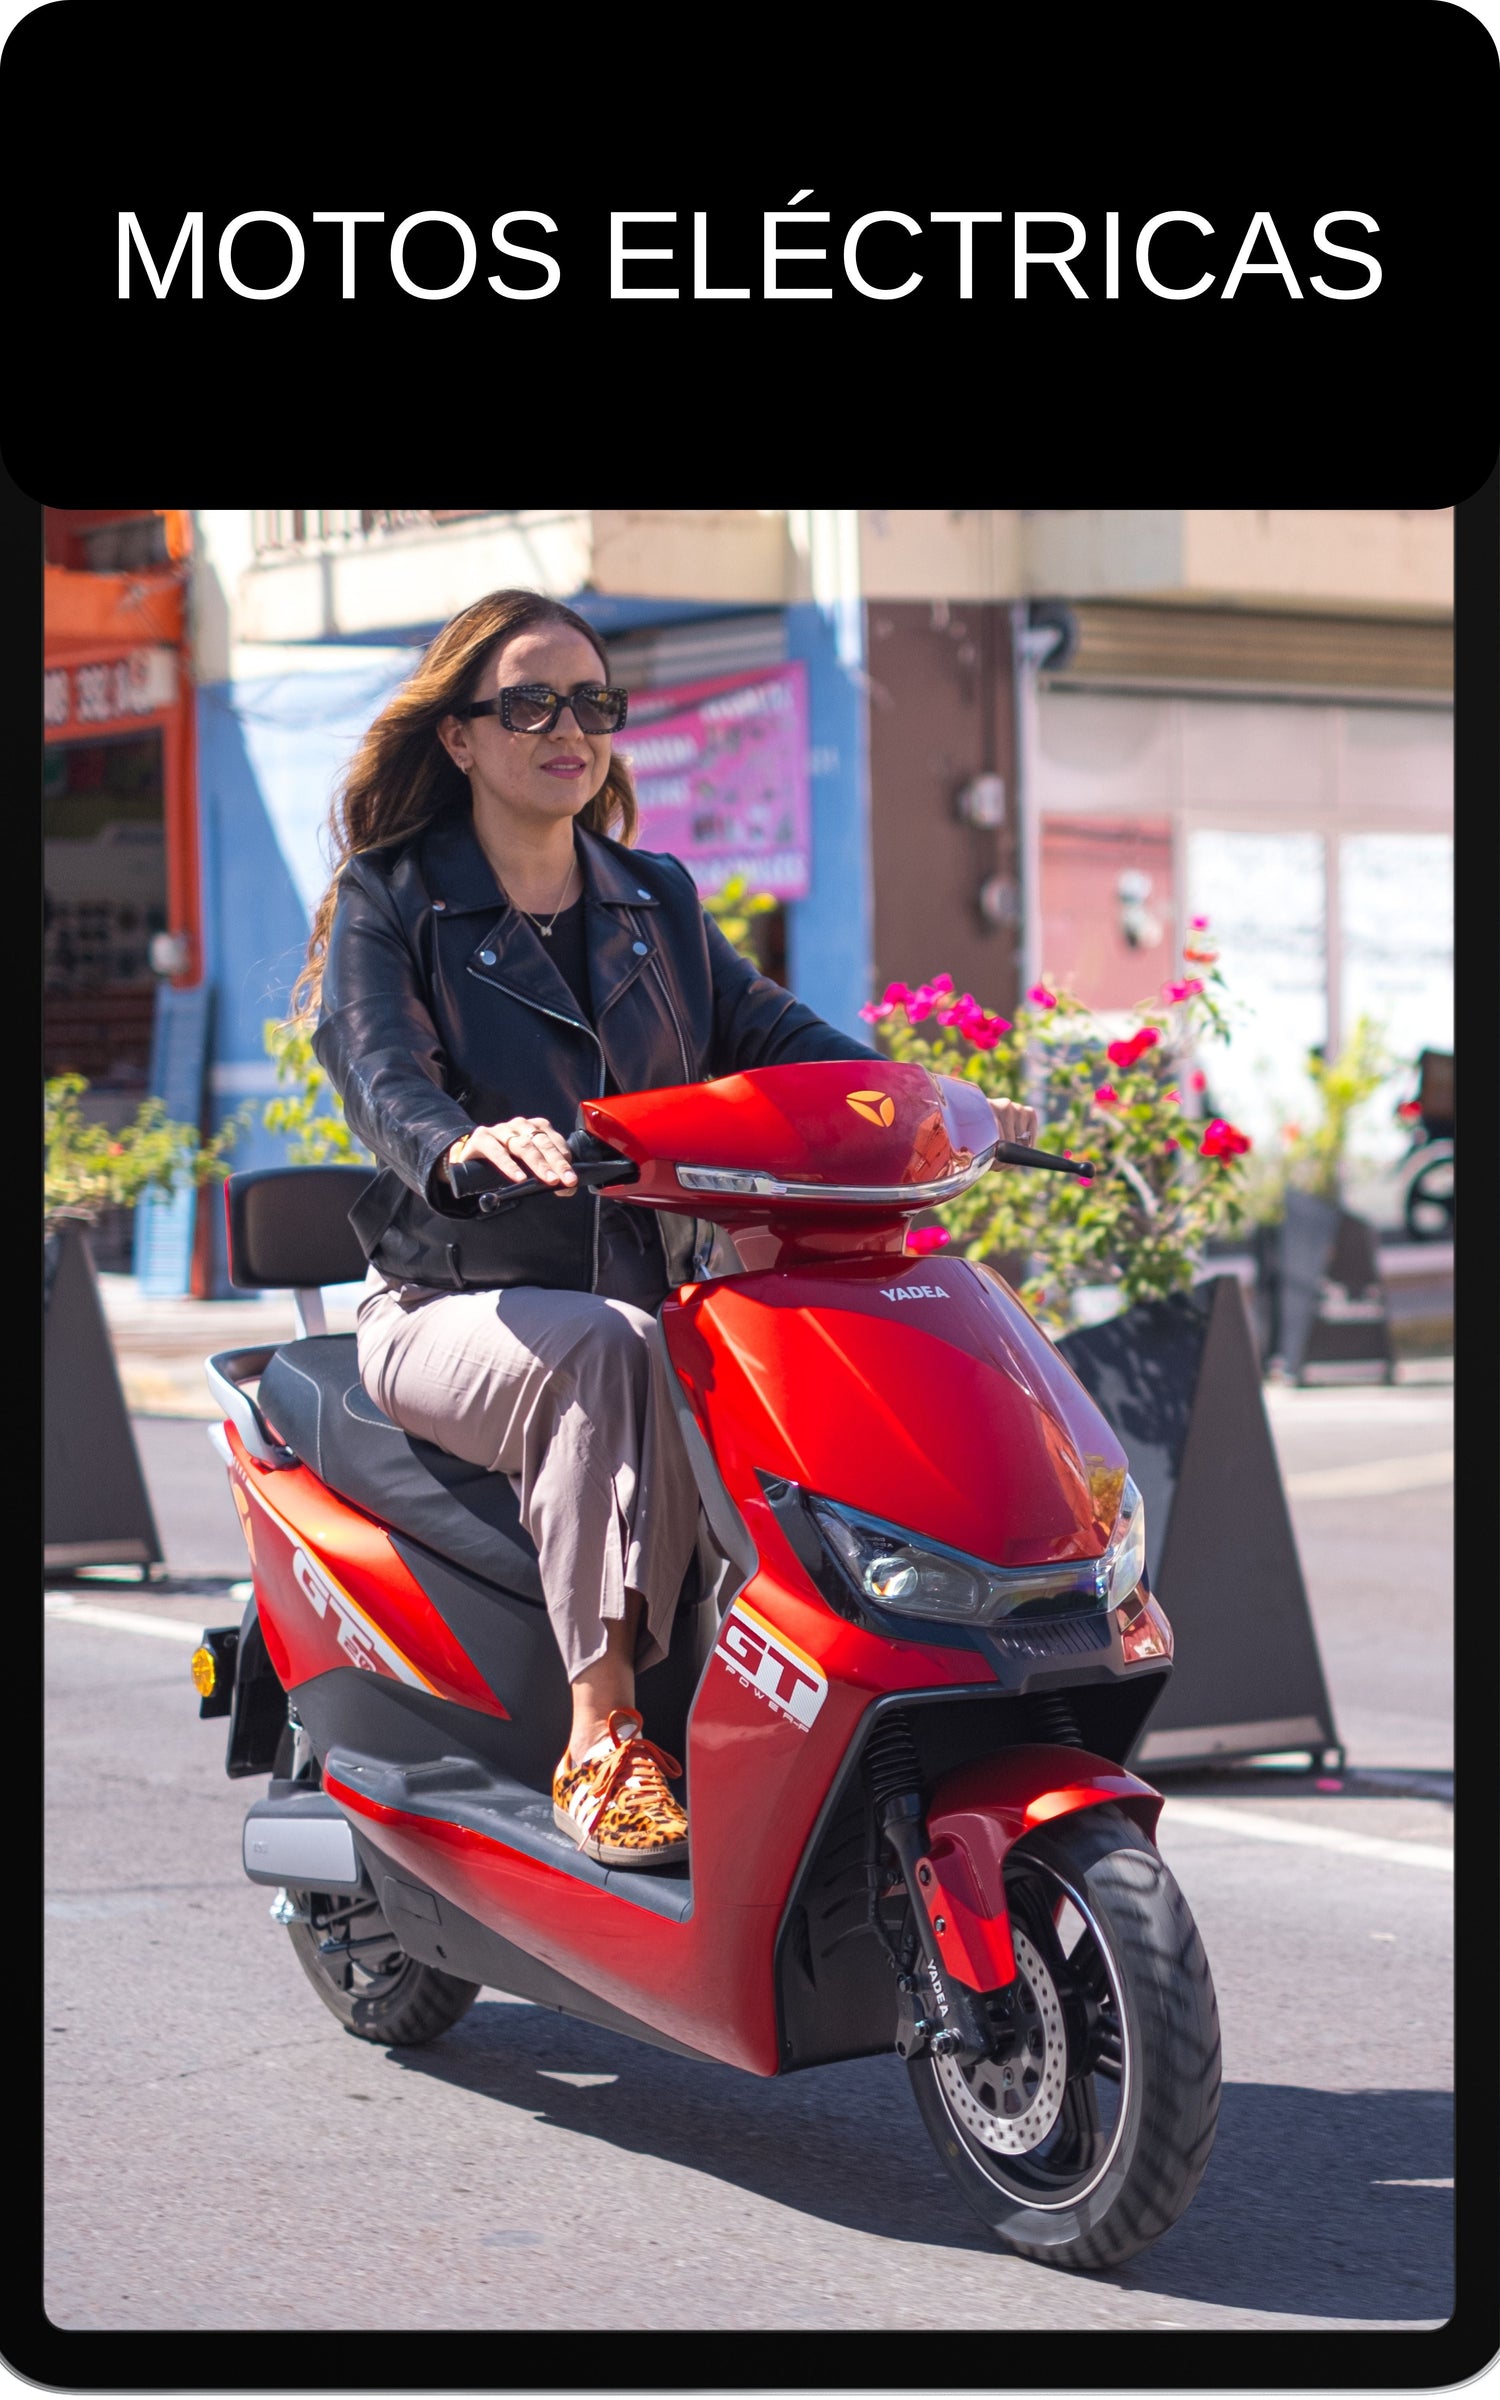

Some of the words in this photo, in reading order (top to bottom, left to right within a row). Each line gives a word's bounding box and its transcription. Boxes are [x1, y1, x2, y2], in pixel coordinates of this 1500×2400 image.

[880, 1285, 951, 1302] YADEA
[293, 1548, 374, 1651] GT
[718, 1614, 819, 1704] GT
[926, 1958, 950, 2018] YADEA
